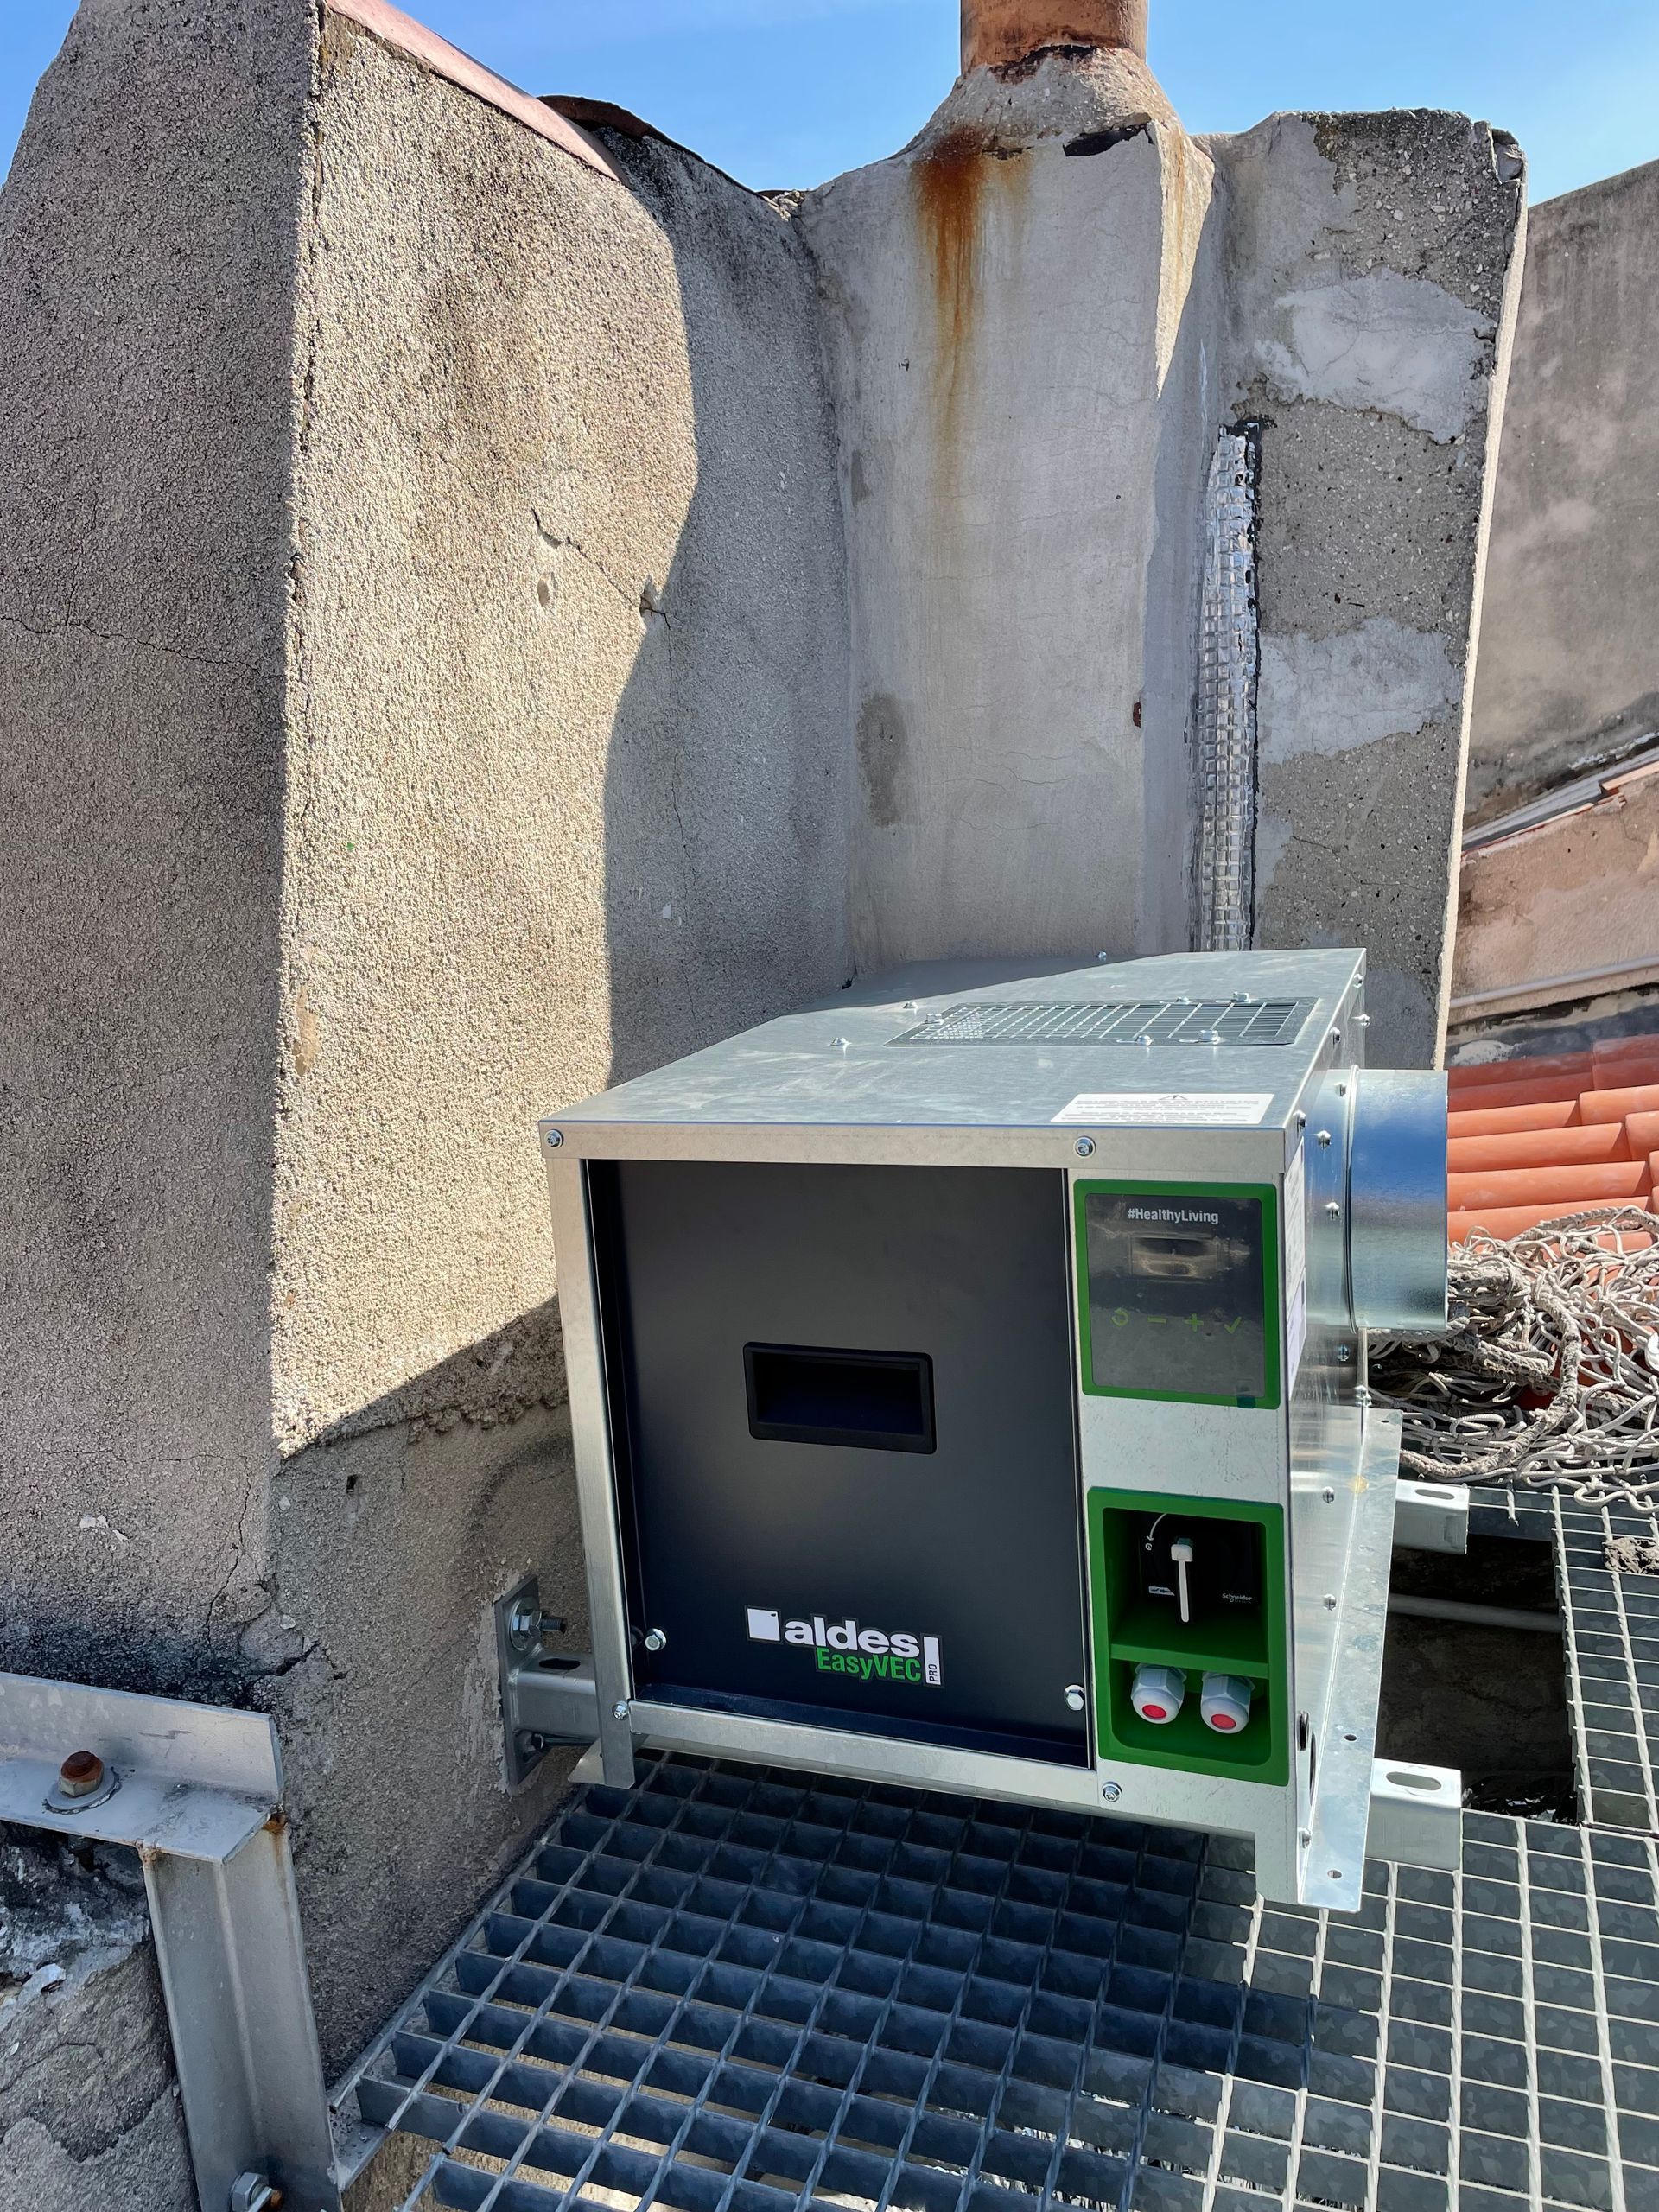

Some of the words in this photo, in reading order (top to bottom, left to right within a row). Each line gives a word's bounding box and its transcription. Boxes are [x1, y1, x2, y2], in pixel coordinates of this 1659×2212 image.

[1128, 1208, 1219, 1225] #HealthyLiving
[785, 1616, 920, 1658] aldes
[817, 1648, 921, 1681] EasyVEC
[928, 1663, 938, 1682] PRO
